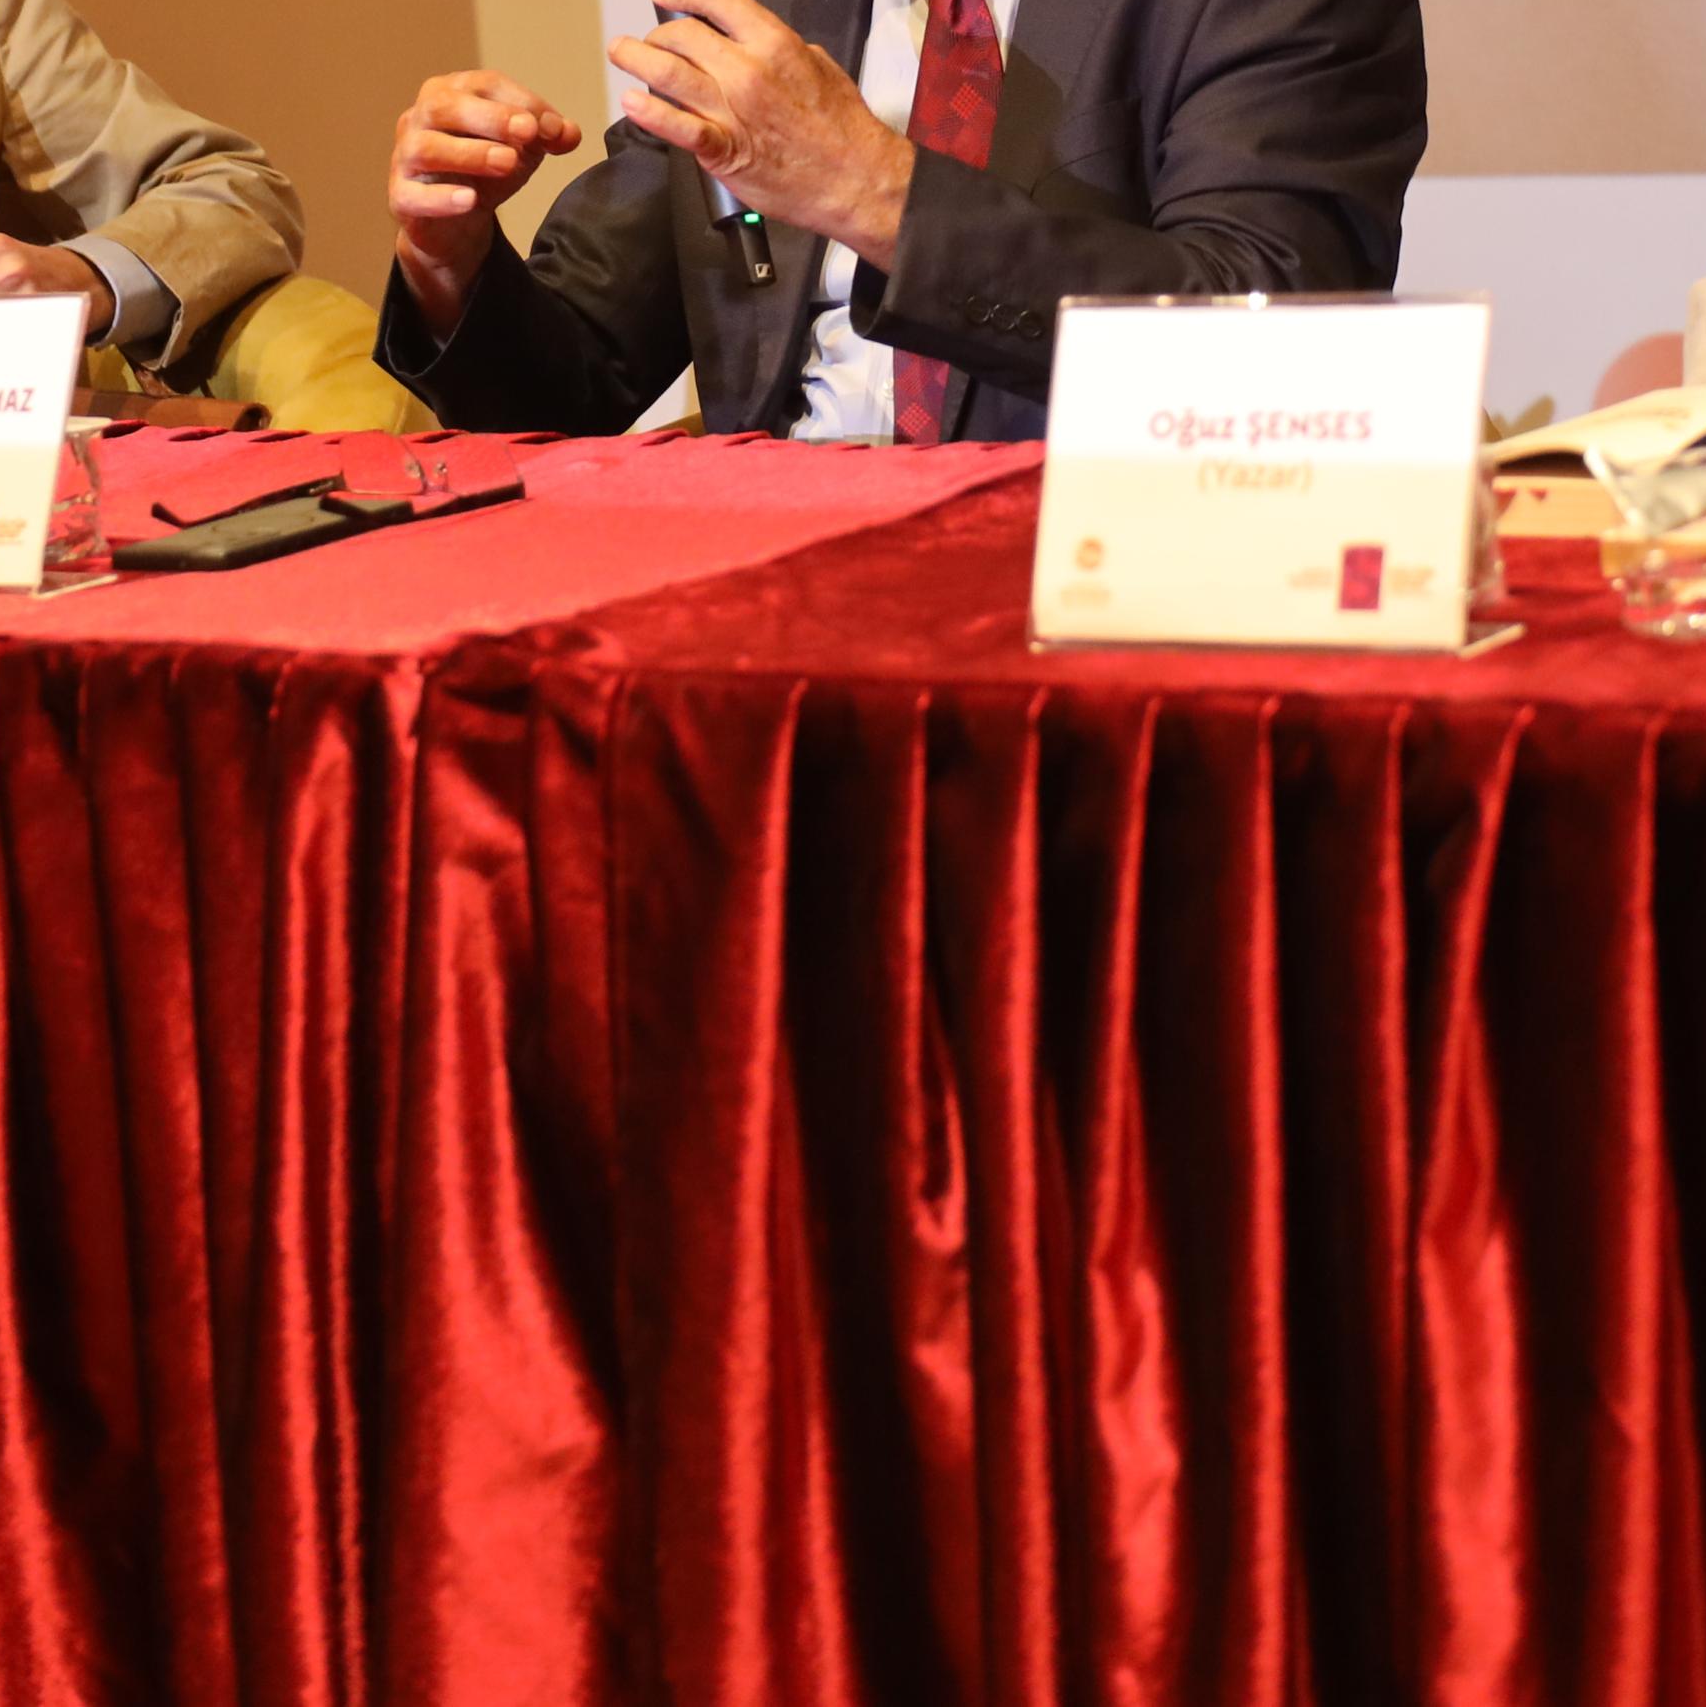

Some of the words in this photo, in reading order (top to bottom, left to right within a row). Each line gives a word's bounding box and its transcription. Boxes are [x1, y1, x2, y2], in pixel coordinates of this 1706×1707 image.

[1149, 407, 1236, 450] Oğuz
[1246, 409, 1372, 448] ŞENSES
[1197, 457, 1314, 496] (Yazar)
